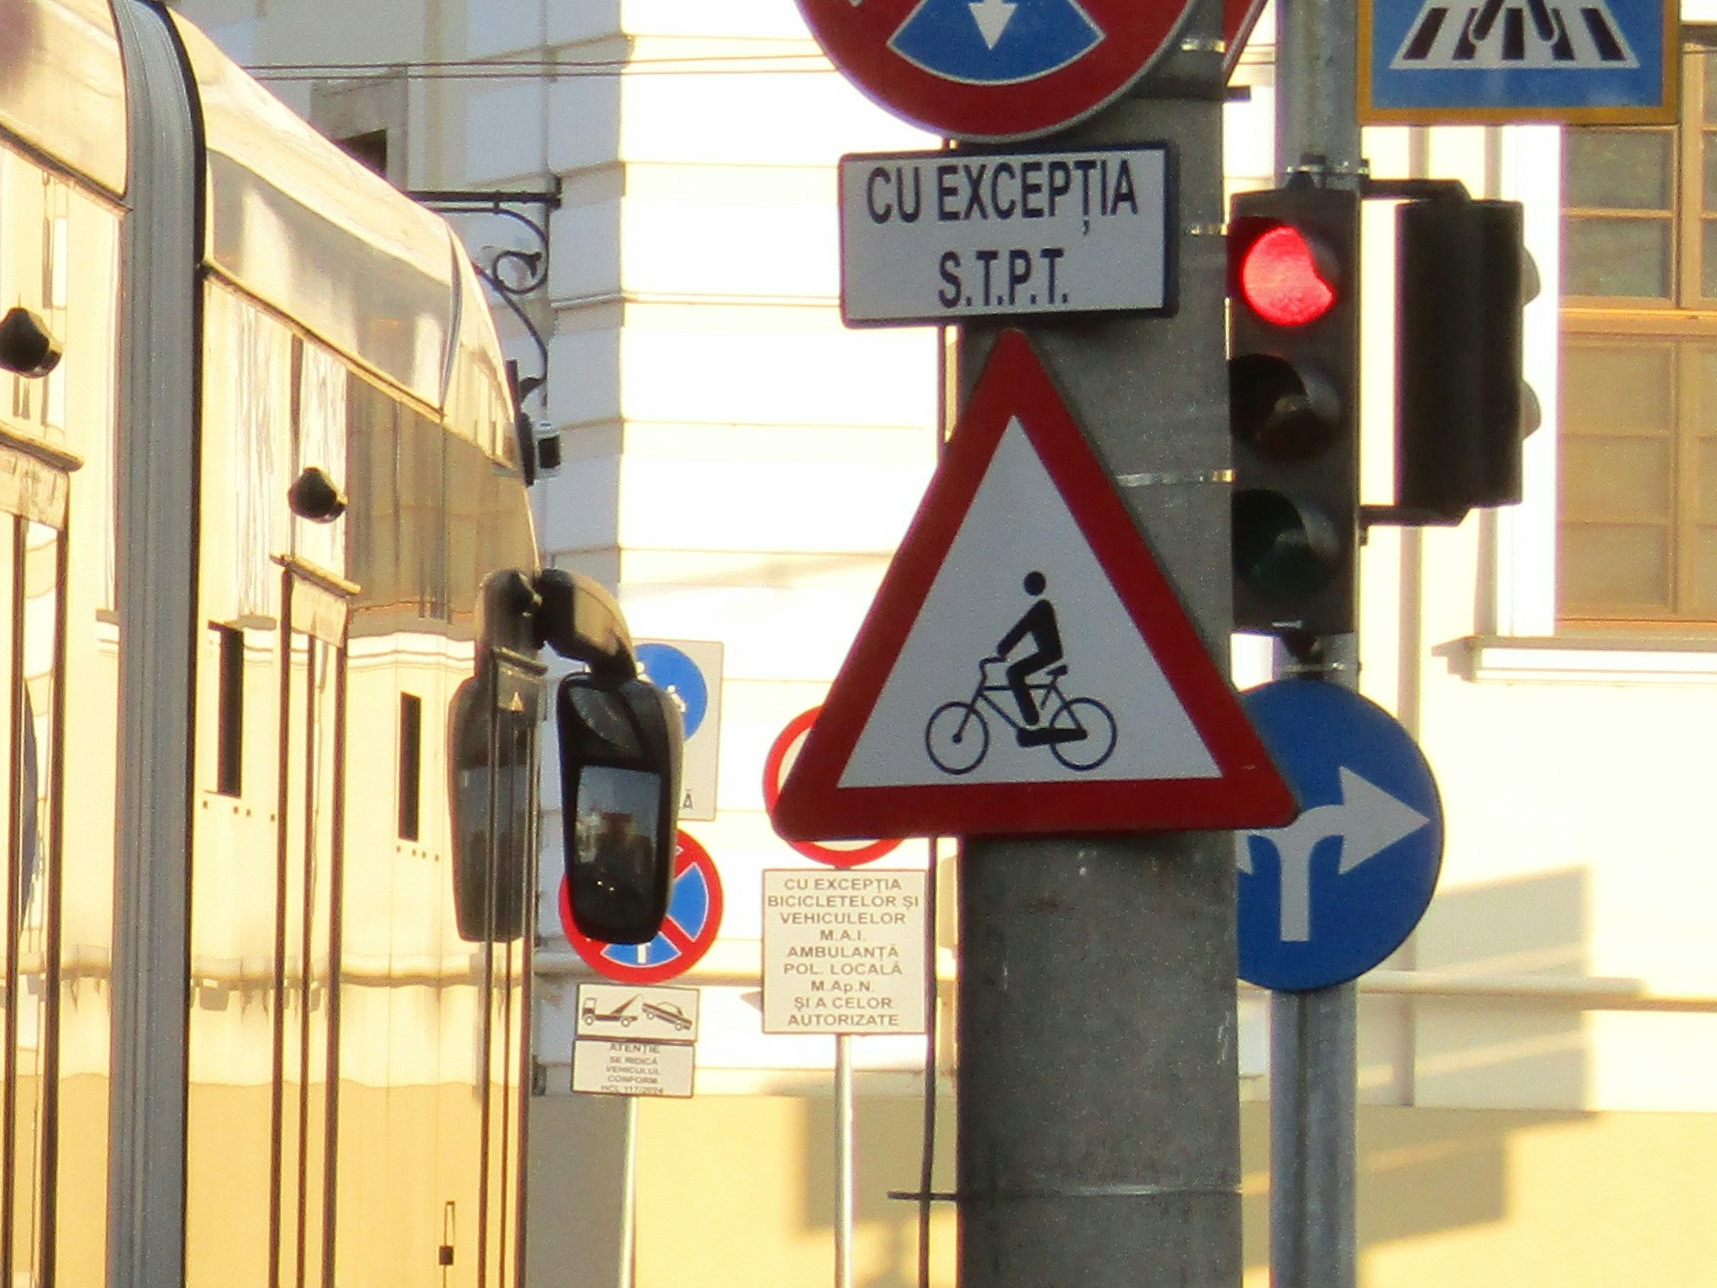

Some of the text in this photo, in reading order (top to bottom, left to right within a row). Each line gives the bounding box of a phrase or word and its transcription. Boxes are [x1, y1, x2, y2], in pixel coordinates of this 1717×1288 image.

[866, 159, 1139, 236] CU EXCEPȚIA
[938, 247, 1069, 309] S.T.P.T.
[783, 878, 809, 891] CU
[767, 895, 897, 908] BICICLETELOR
[780, 912, 906, 925] VEHICULELOR
[820, 929, 867, 941] M.A.I.
[811, 980, 875, 994] M.Ap.N.
[815, 997, 827, 1009] A
[832, 997, 893, 1009] CELOR
[787, 1014, 900, 1027] AUTORIZATE
